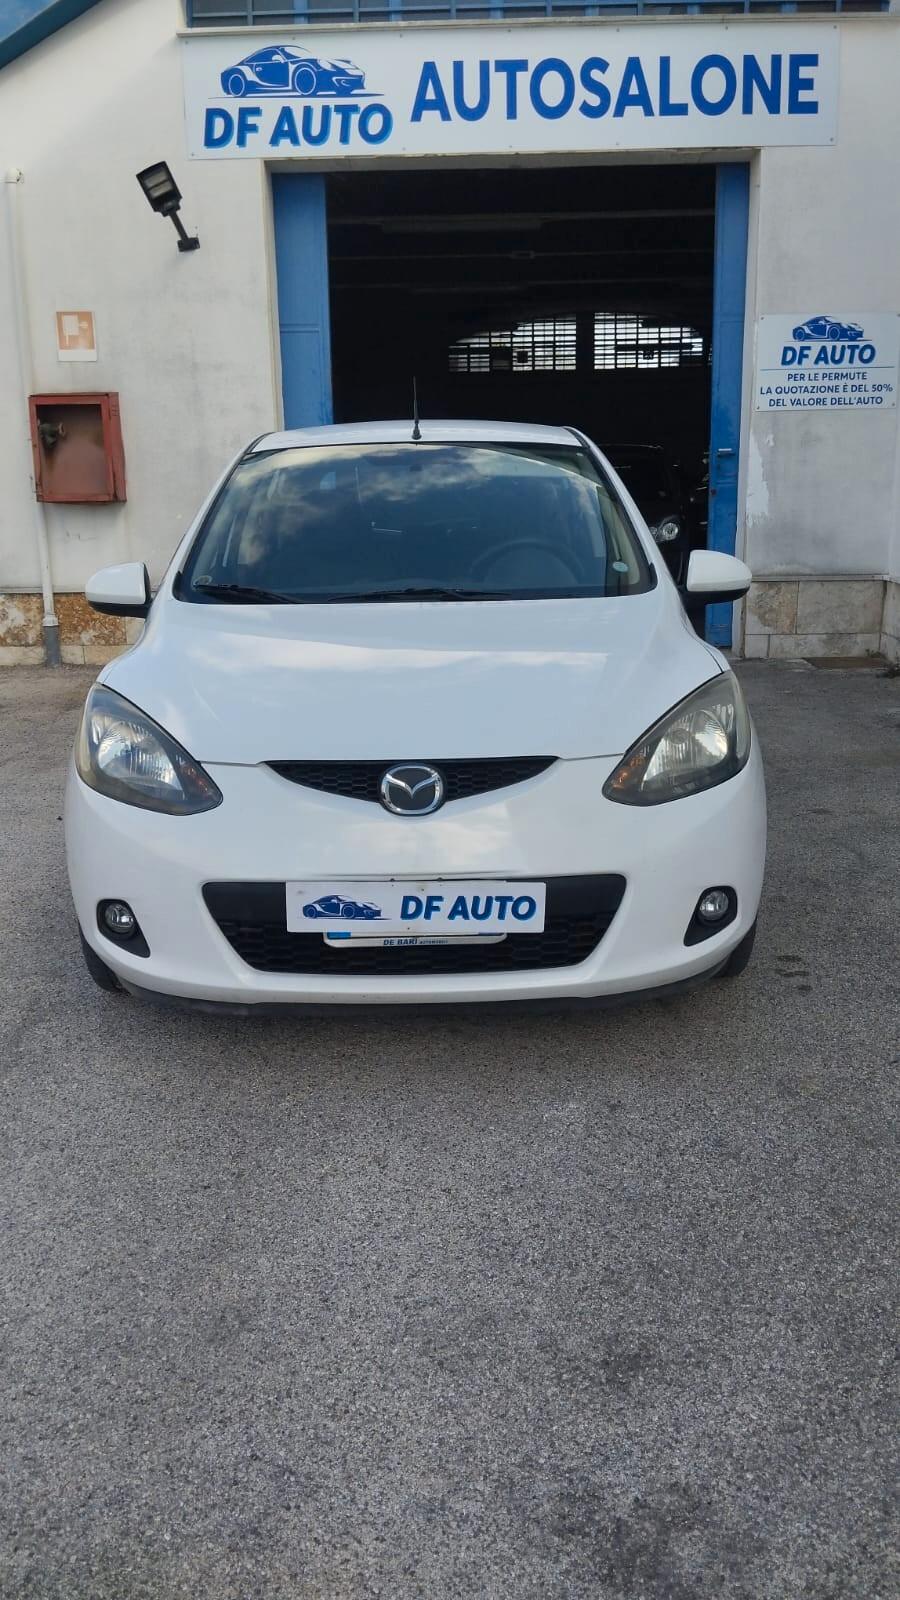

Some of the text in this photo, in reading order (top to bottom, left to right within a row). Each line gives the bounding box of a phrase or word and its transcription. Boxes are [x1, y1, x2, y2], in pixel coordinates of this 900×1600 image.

[410, 53, 819, 122] AUTOSALONE
[203, 103, 393, 149] DF AUTO
[780, 344, 876, 366] DF AUTO
[787, 371, 868, 382] PER LE PERMUTE
[760, 386, 773, 395] LA
[775, 384, 840, 395] QUOTAZIONE
[851, 384, 869, 393] DEL
[871, 383, 894, 393] 50%
[768, 396, 884, 407] DEL VALORE DELL'AUTO
[400, 895, 537, 921] DF AUTO
